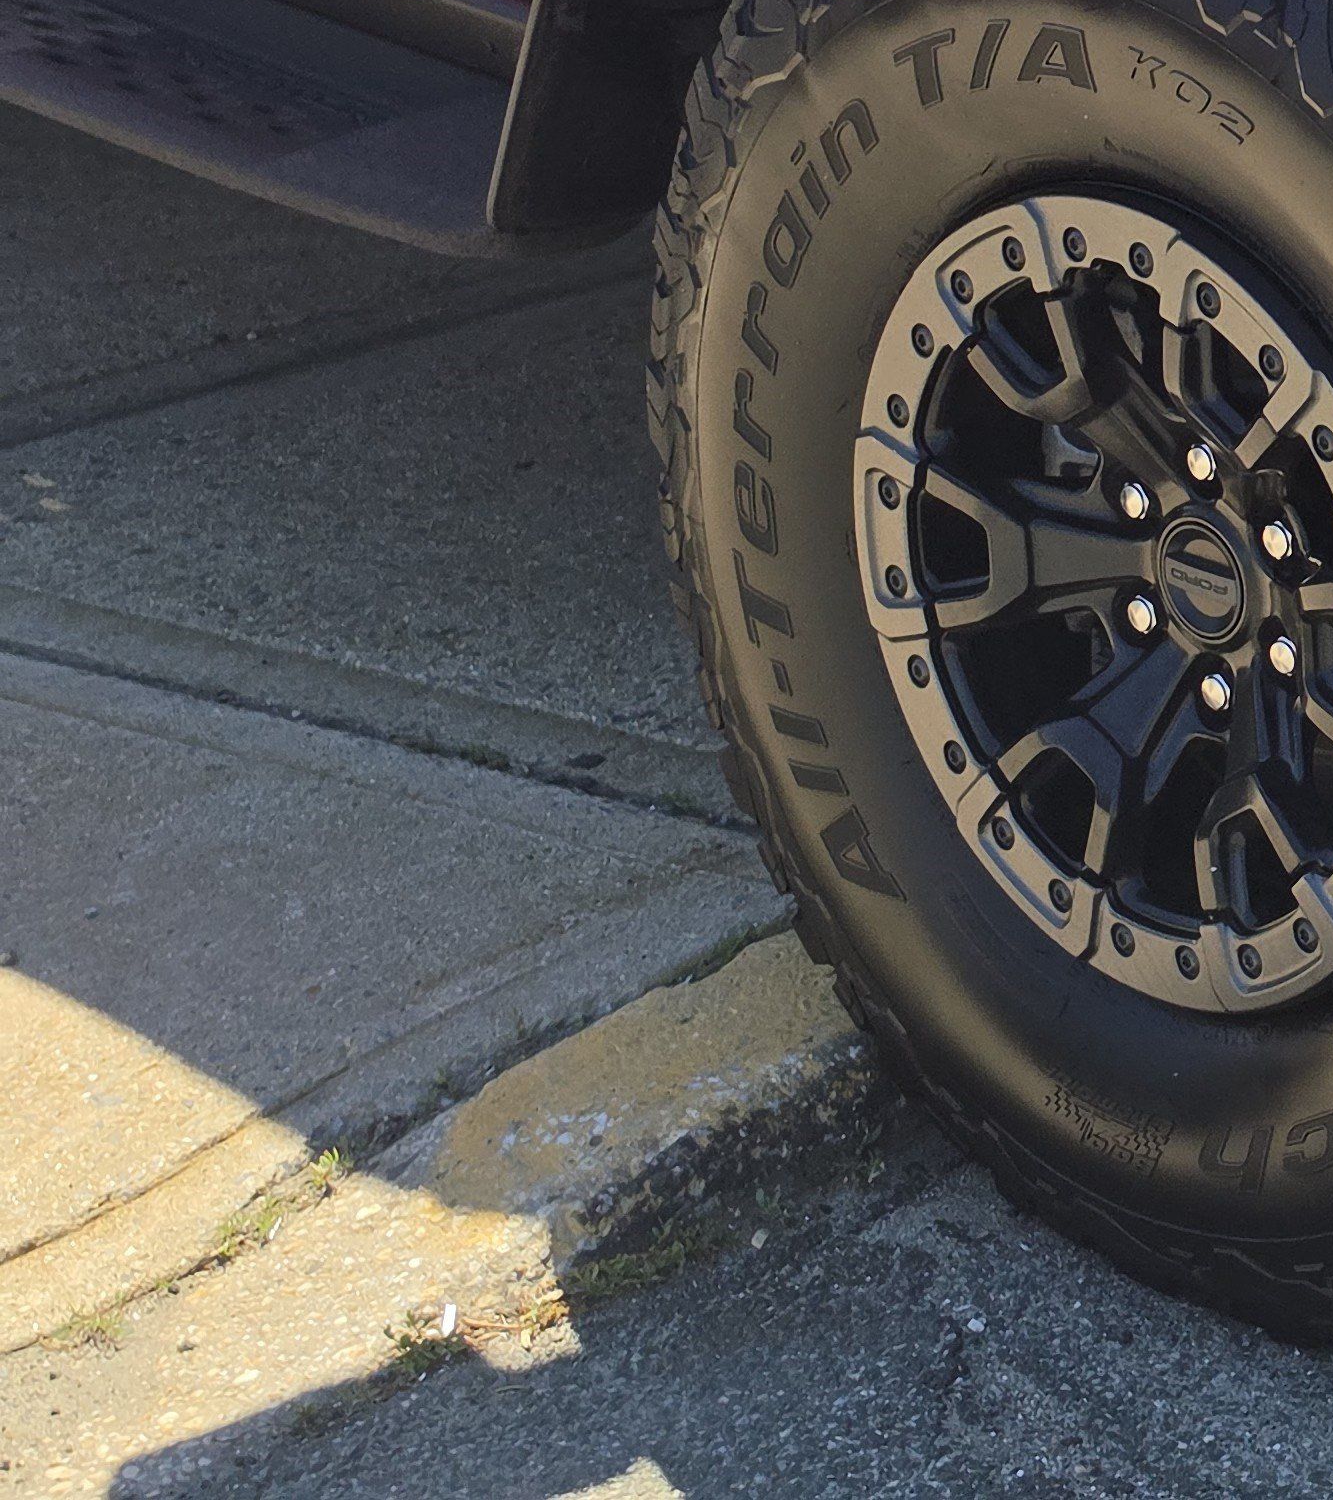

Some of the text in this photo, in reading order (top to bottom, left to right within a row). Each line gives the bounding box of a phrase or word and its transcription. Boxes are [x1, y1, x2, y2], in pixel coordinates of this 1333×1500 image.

[733, 18, 1255, 901] All-Terrain T/A KO2
[1170, 566, 1229, 596] FORD
